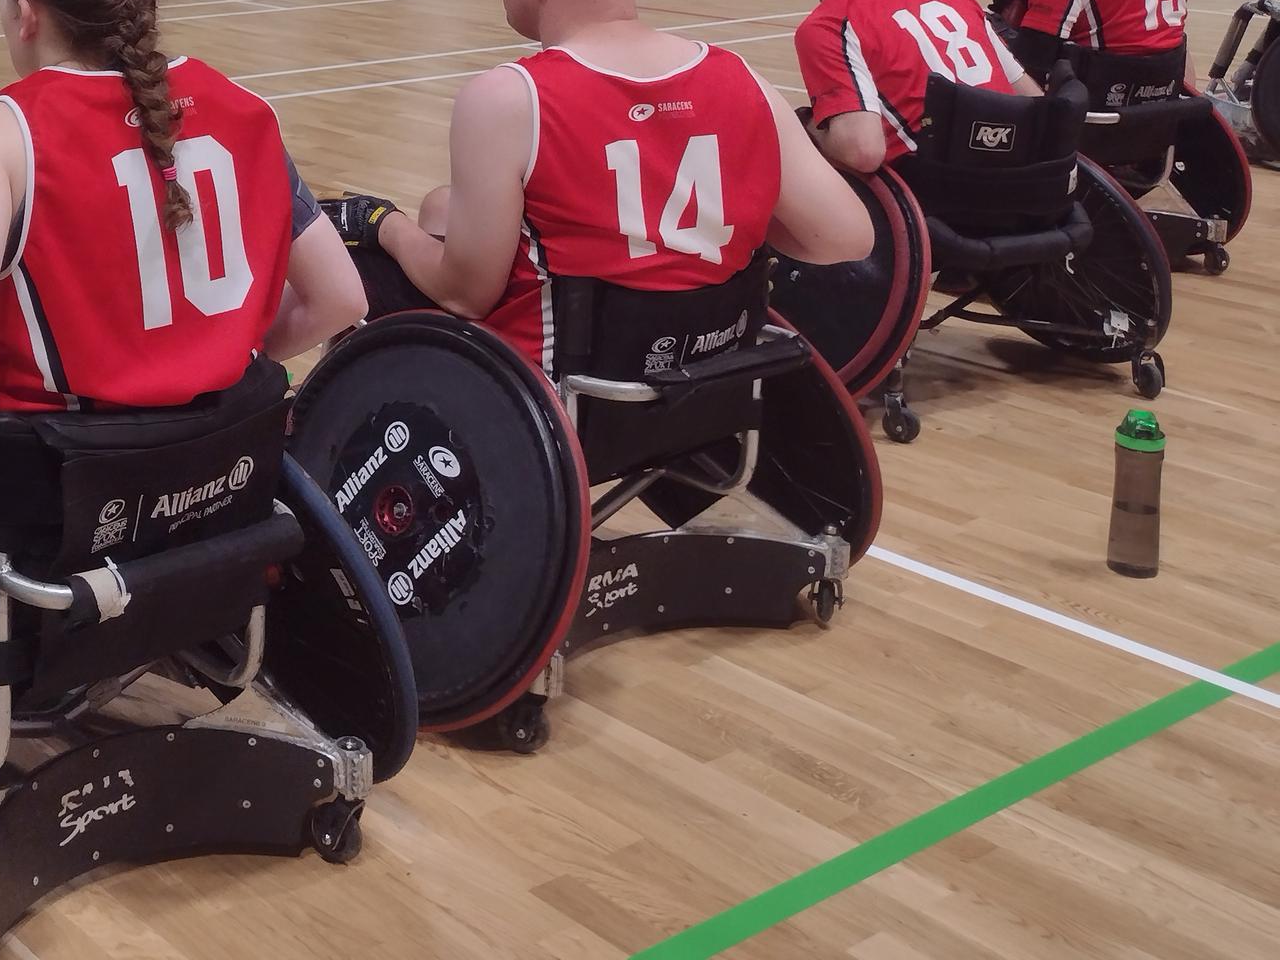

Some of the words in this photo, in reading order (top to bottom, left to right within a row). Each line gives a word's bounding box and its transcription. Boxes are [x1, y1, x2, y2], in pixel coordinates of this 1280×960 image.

[891, 0, 995, 87] 18
[657, 100, 694, 112] SARACENS
[604, 133, 735, 265] 14
[111, 134, 255, 331] 10
[690, 323, 737, 355] Allianz
[150, 474, 226, 519] Allianz
[333, 445, 389, 514] Allianz
[412, 454, 446, 499] SARACENS
[353, 527, 380, 568] SPORT
[407, 508, 467, 579] Allianz
[59, 792, 137, 847] Sport
